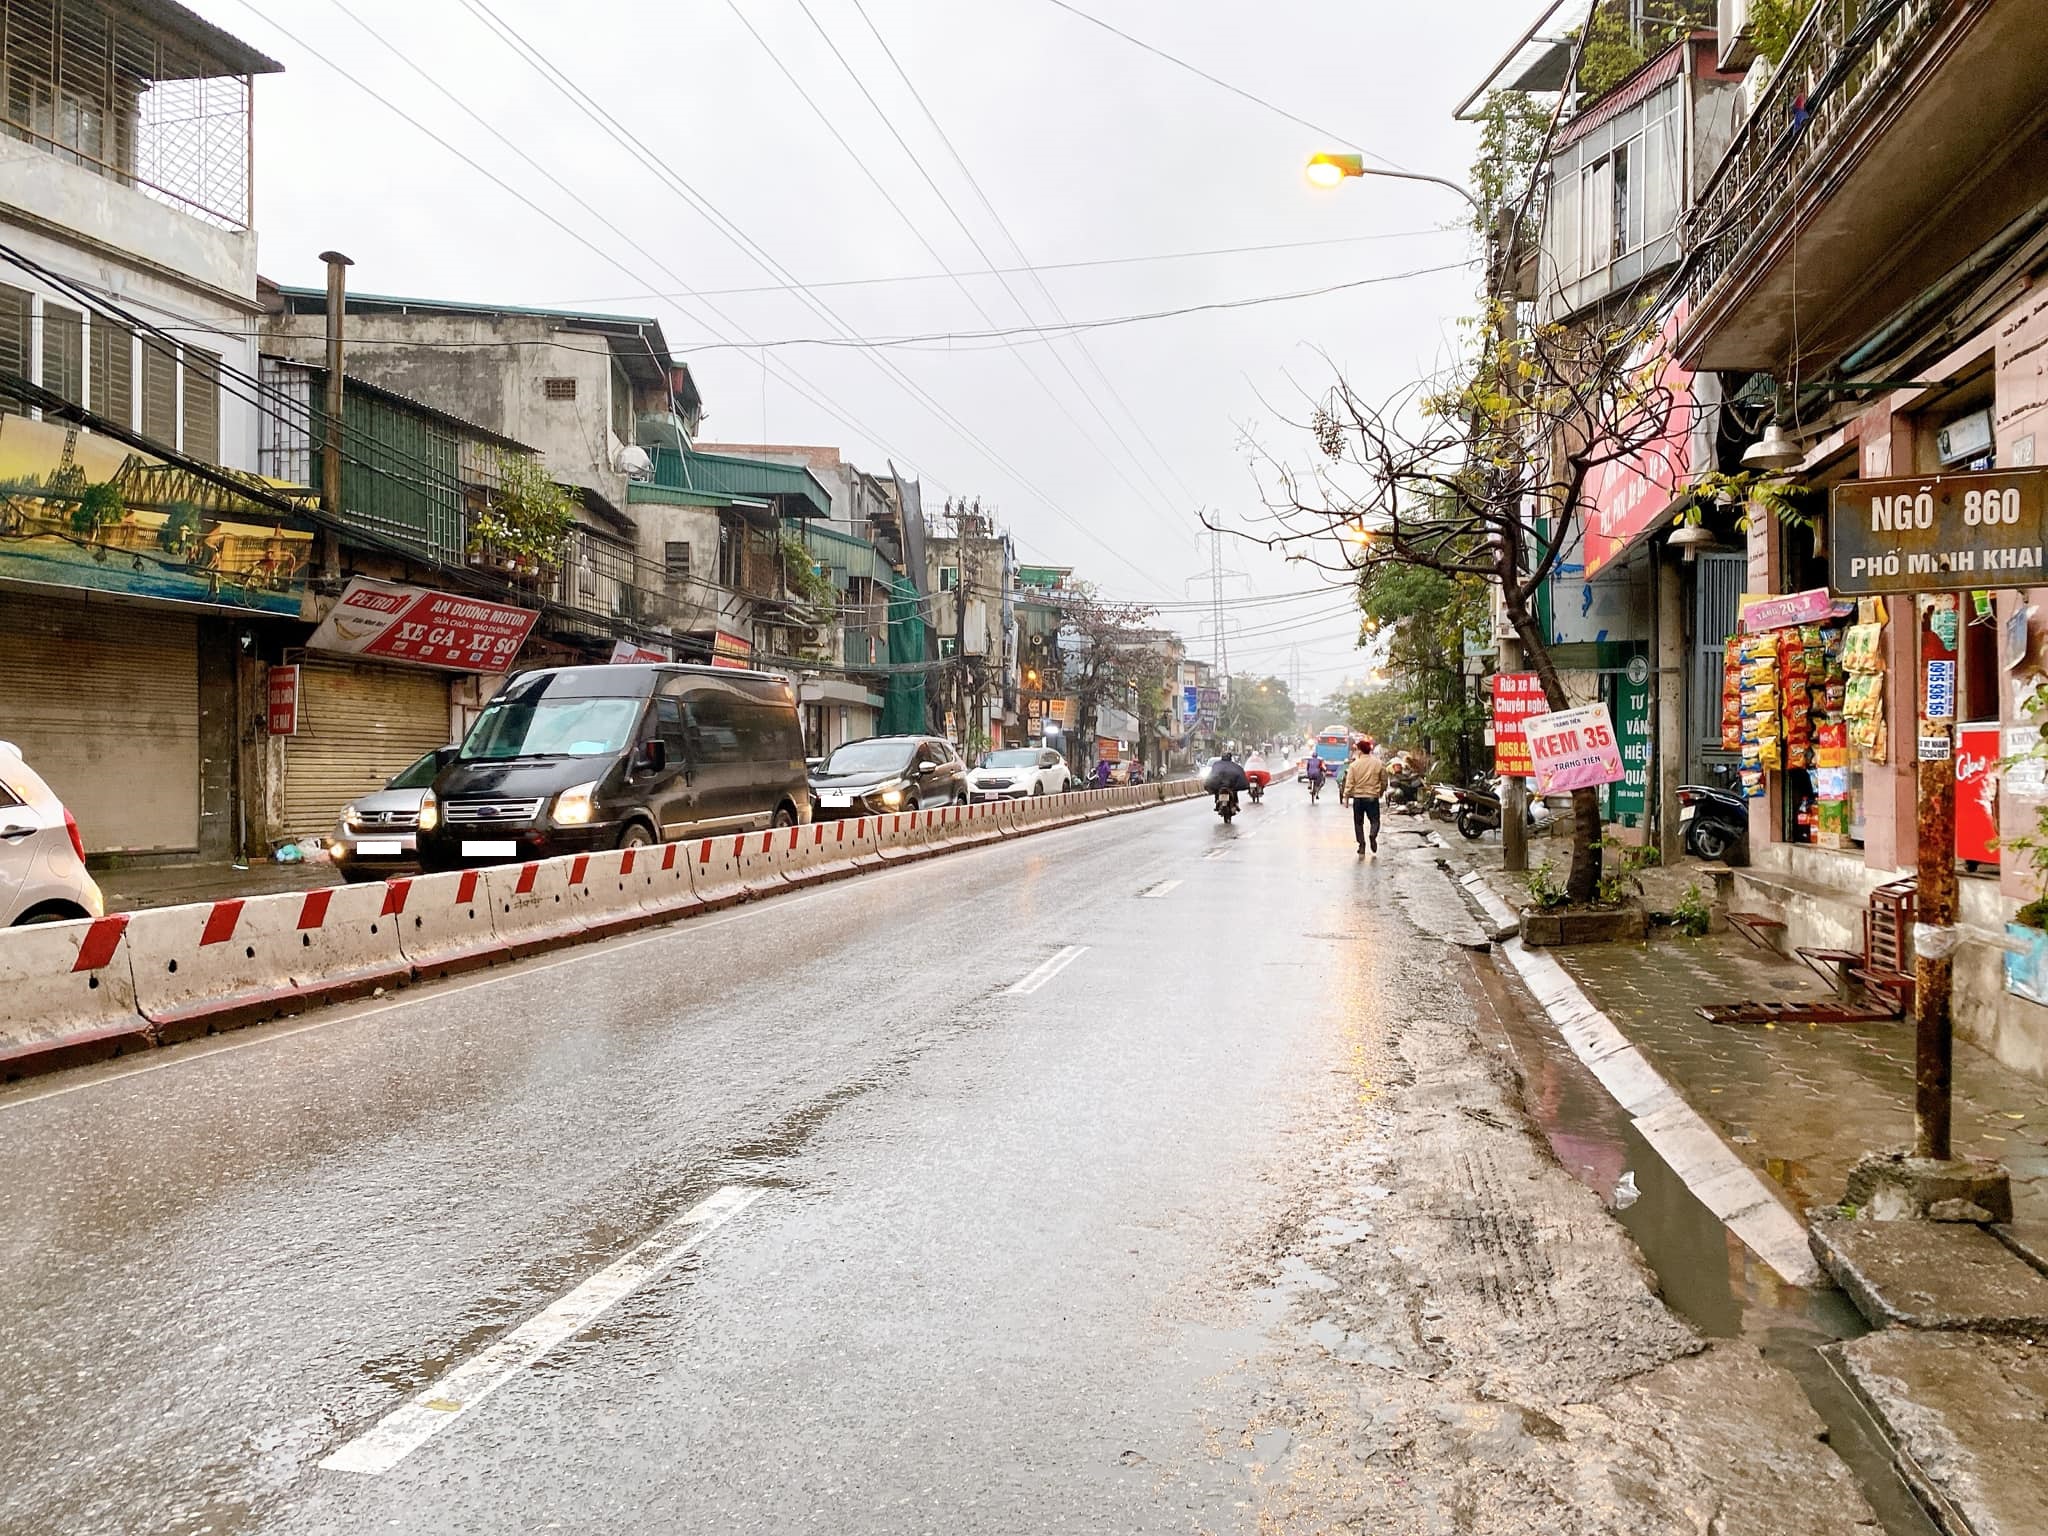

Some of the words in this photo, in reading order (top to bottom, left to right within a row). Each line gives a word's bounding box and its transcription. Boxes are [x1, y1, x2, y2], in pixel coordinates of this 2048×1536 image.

[1871, 486, 1934, 532] NGÕ
[1964, 488, 2020, 526] 860
[1851, 547, 1902, 578] PHỐ
[1983, 546, 2043, 570] KHAI
[430, 600, 453, 613] AN
[491, 610, 528, 627] MOTOR
[395, 621, 428, 642] XE
[428, 628, 455, 646] GA
[466, 633, 494, 651] XE
[494, 632, 524, 655] SỐ
[1929, 662, 1945, 682] 0915
[1500, 676, 1516, 692] Rửa
[1518, 681, 1527, 692] xe
[1929, 684, 1944, 700] 936
[1496, 698, 1526, 714] Chuyên
[1630, 694, 1645, 710] TƯ
[1928, 701, 1944, 716] 156
[1626, 715, 1649, 735] VẤN
[1533, 730, 1579, 759] KEM
[1583, 725, 1611, 748] 35
